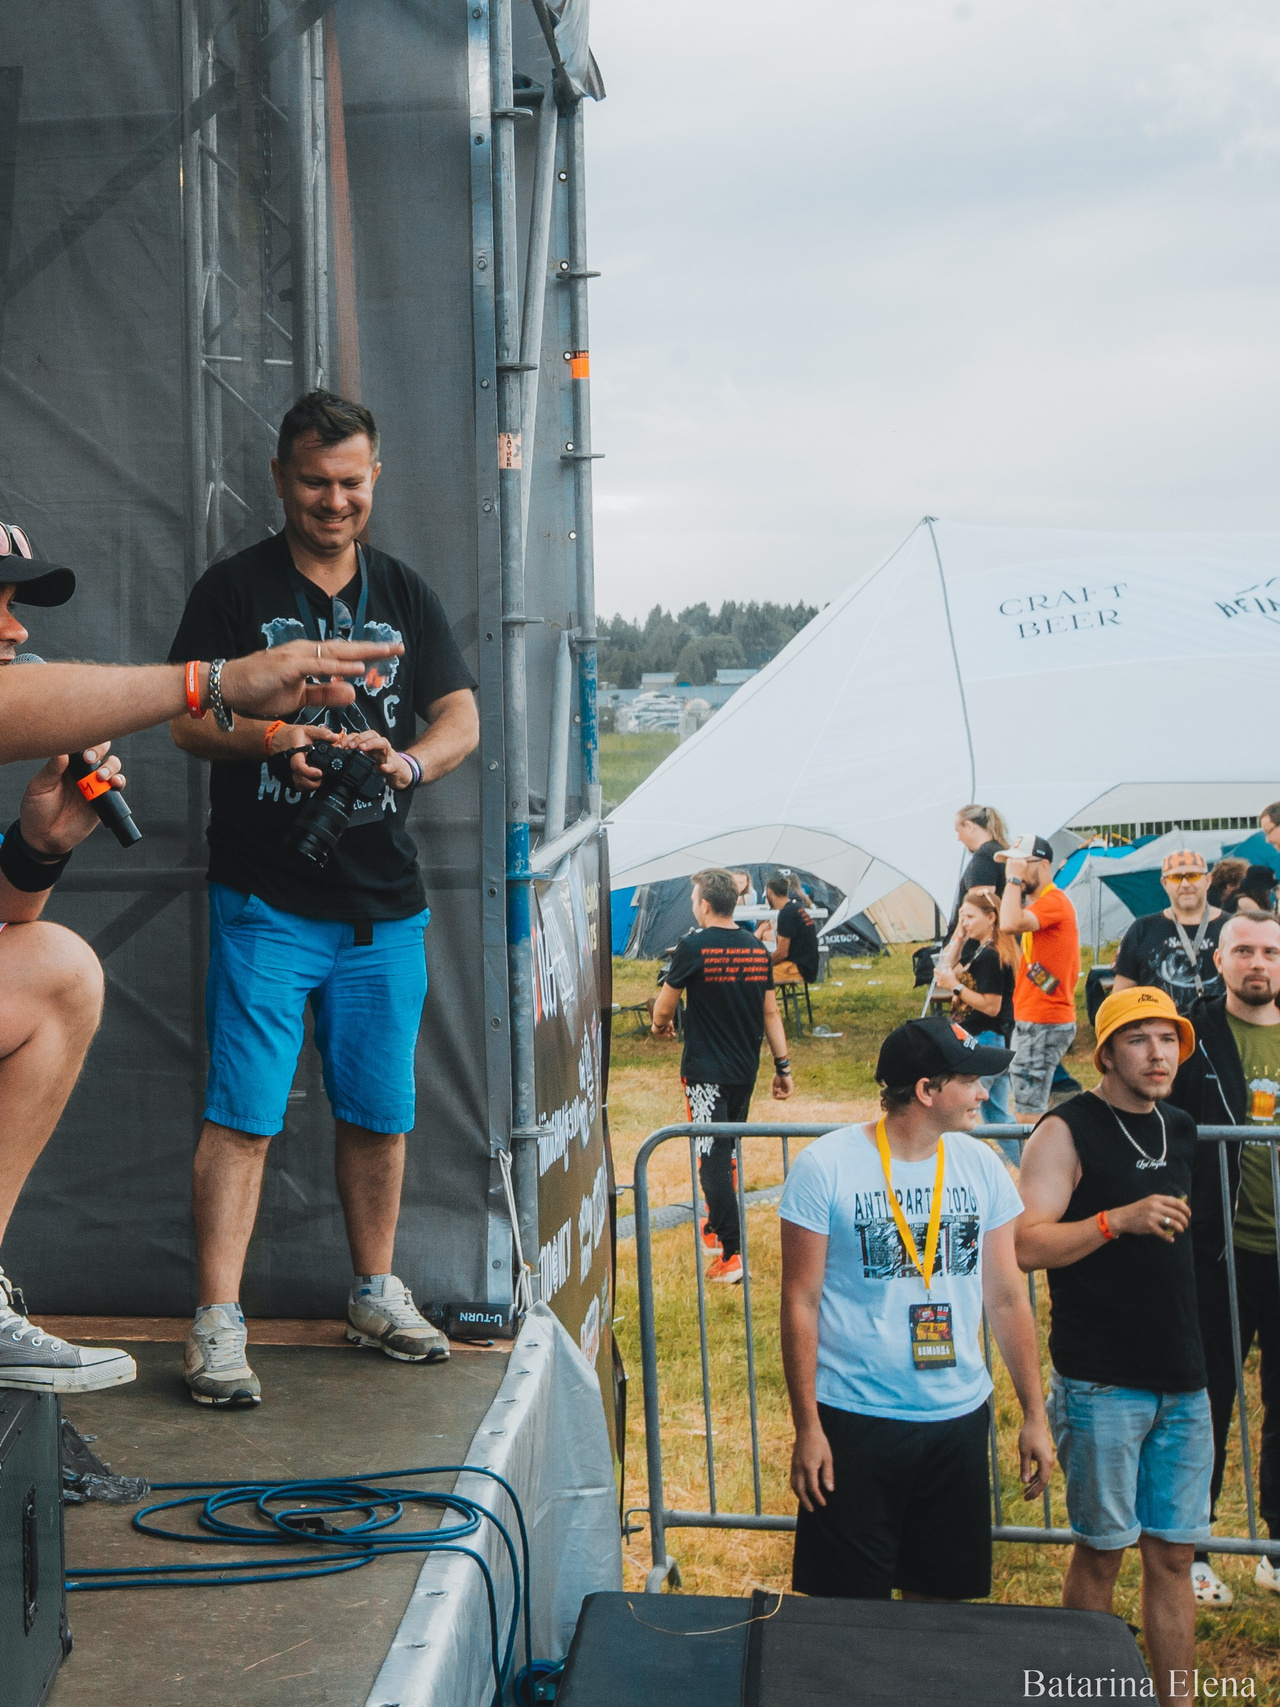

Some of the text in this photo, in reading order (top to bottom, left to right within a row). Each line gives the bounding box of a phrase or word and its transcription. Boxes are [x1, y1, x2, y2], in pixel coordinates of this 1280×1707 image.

[999, 582, 1128, 617] CRAFT
[1018, 609, 1123, 640] BEER
[894, 1186, 936, 1215] PART
[460, 1312, 503, 1326] U-TURN
